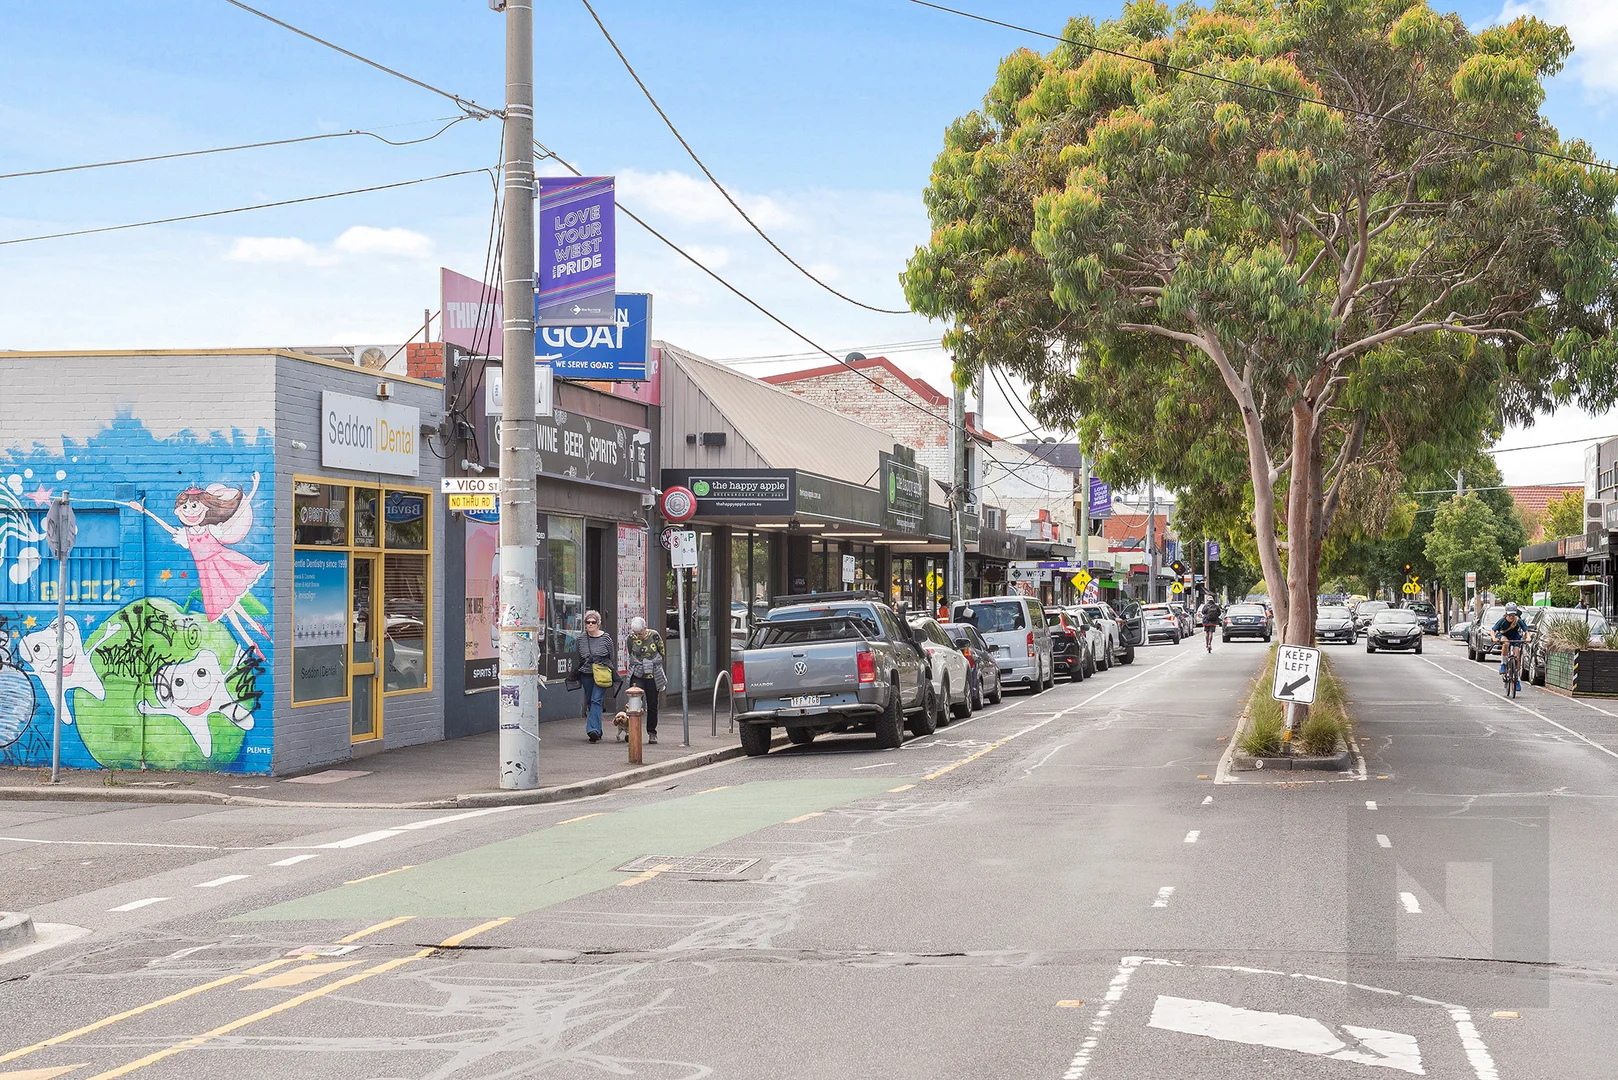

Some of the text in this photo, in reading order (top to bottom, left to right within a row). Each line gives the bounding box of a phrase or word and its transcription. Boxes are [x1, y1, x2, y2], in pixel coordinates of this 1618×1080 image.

[554, 205, 601, 231] LOVE
[554, 221, 602, 246] YOUR
[554, 237, 602, 263] WEST
[557, 253, 602, 278] PRIDE
[446, 302, 503, 329] THIRSTY
[542, 321, 630, 349] GOAT
[555, 360, 614, 369] WE SERVE GOATS
[328, 410, 414, 455] Seddon Dental
[536, 423, 558, 453] WINE
[564, 430, 584, 459] BEER
[589, 436, 618, 466] SPIRITS
[457, 480, 499, 491] VIGO ST
[712, 481, 785, 491] the happy apple
[451, 497, 491, 507] NO THRU RD
[306, 558, 326, 570] Dentistry
[326, 559, 338, 568] since
[1285, 650, 1313, 661] KEEP
[472, 668, 492, 679] SPIRITS
[1284, 661, 1310, 673] LEFT
